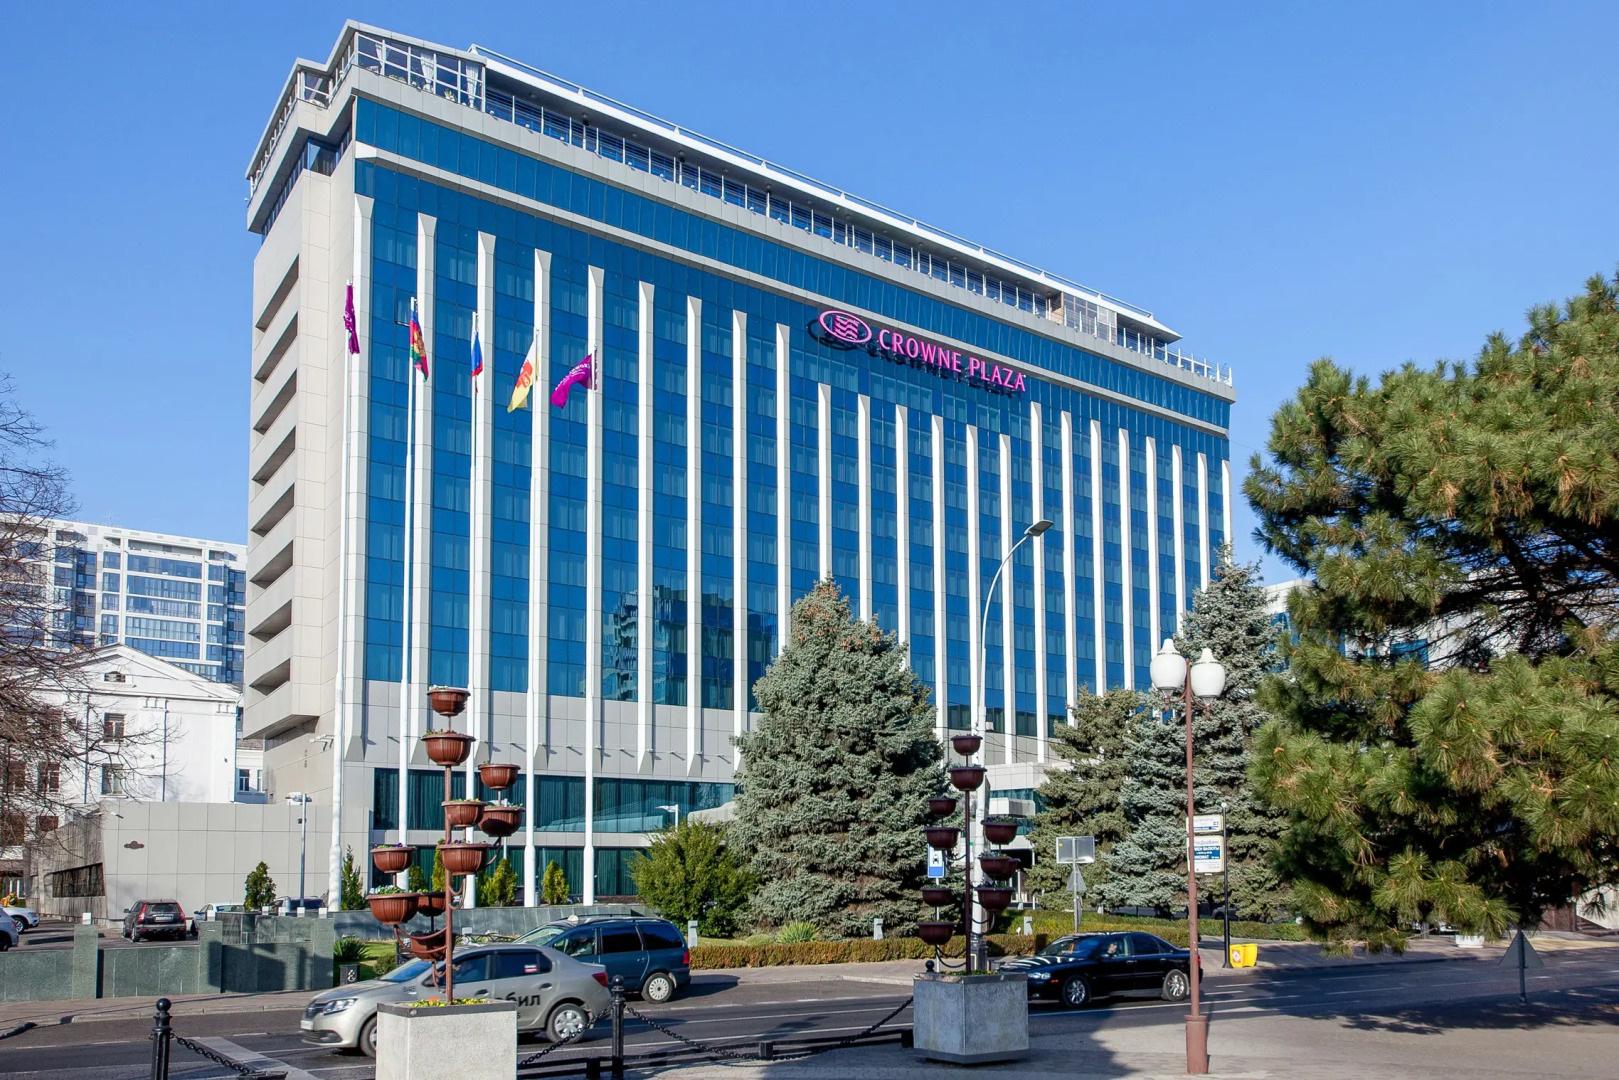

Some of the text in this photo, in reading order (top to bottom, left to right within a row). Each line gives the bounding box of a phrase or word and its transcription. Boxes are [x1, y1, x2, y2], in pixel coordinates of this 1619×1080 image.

[878, 328, 1026, 392] CROWNE PLAZA
[495, 991, 541, 1007] бил
